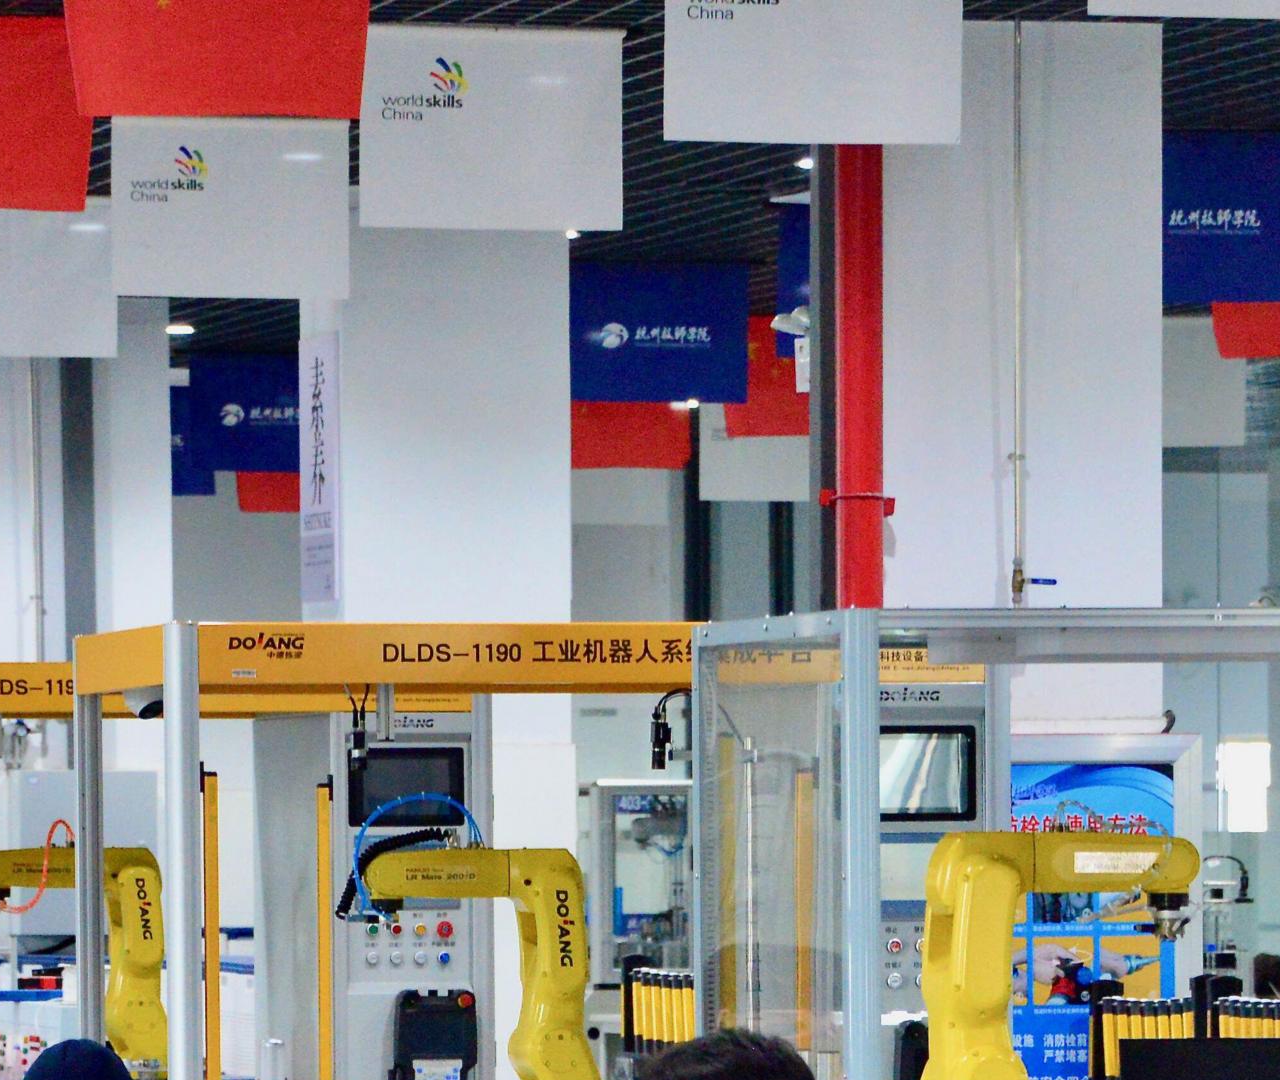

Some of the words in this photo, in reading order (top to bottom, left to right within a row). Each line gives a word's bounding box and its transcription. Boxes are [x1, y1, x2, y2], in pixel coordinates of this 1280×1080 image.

[687, 5, 734, 20] China
[382, 107, 423, 121] China
[130, 190, 168, 202] China
